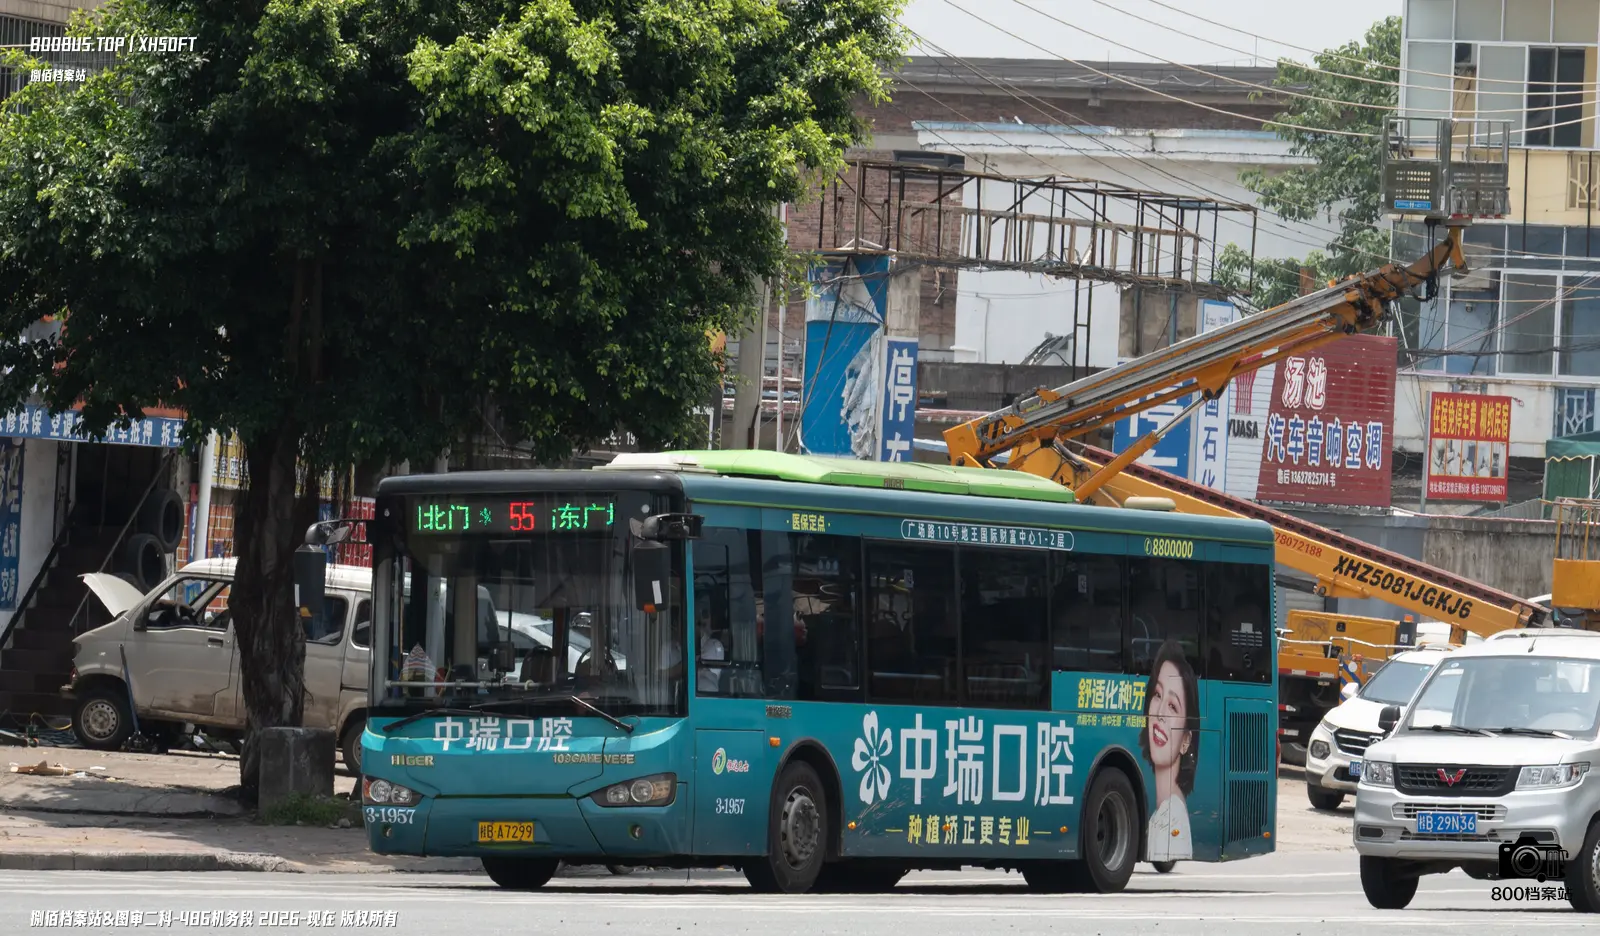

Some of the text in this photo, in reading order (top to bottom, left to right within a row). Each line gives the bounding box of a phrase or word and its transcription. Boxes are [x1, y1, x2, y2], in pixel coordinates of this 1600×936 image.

[1228, 419, 1259, 439] YUASA
[1267, 412, 1383, 470] 汽车音响空调
[509, 502, 535, 531] 55
[907, 522, 1065, 548] 广场路10号地王国际财富中心1-2层
[1152, 537, 1193, 558] 8800000
[1333, 555, 1473, 619] XHZ5081JGKJ6
[1078, 678, 1146, 711] 舒适化种牙
[433, 716, 573, 752] 中瑞口腔
[391, 755, 434, 766] HIGER
[900, 713, 1074, 807] 中瑞口腔
[366, 807, 416, 824] 3-1957
